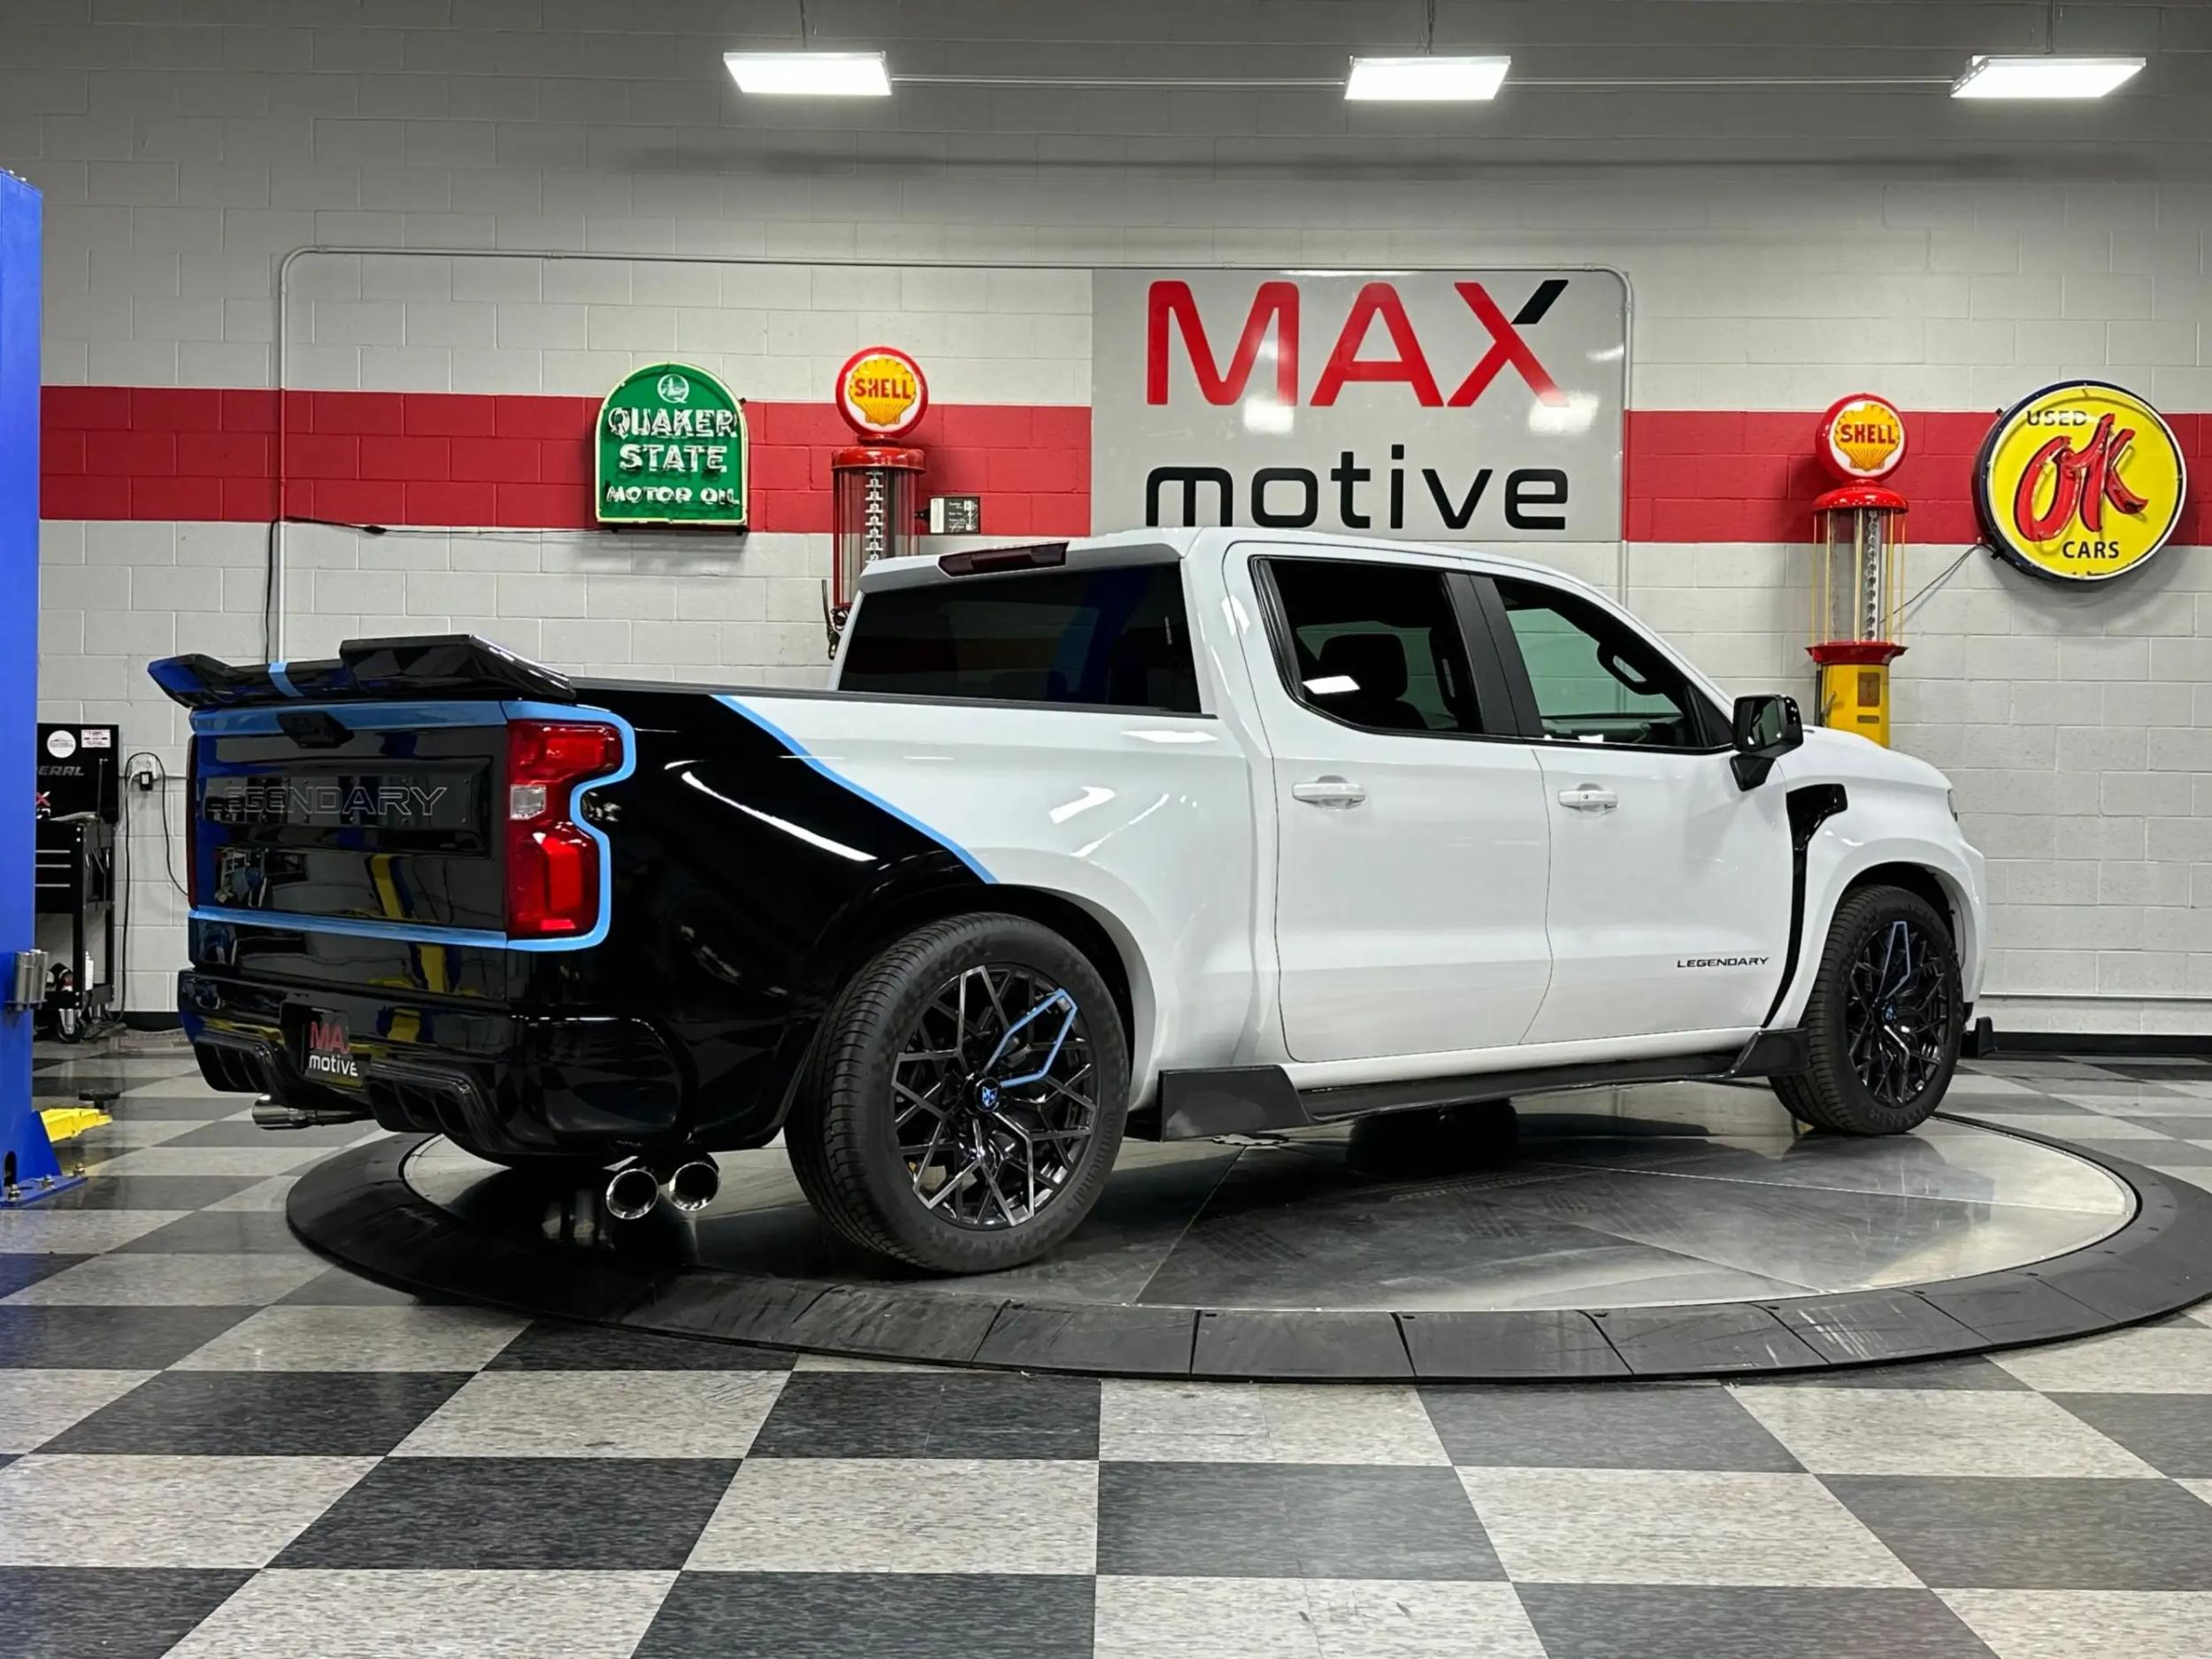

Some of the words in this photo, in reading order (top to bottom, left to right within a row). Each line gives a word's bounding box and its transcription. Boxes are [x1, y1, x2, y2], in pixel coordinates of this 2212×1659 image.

[1147, 280, 1570, 407] MAX
[854, 378, 911, 400] SHELL
[608, 407, 738, 440] QUAKER
[2026, 411, 2087, 426] USED
[1839, 424, 1895, 444] SHELL
[619, 443, 728, 472] STATE
[1146, 444, 1569, 530] motive
[2014, 413, 2149, 542] OK
[606, 486, 693, 503] MOTOR
[700, 488, 740, 504] OIL
[2062, 541, 2120, 558] CARS
[206, 786, 448, 816] LEGENDARY
[1677, 956, 1770, 968] LEGENDARY
[309, 1054, 358, 1077] motive
